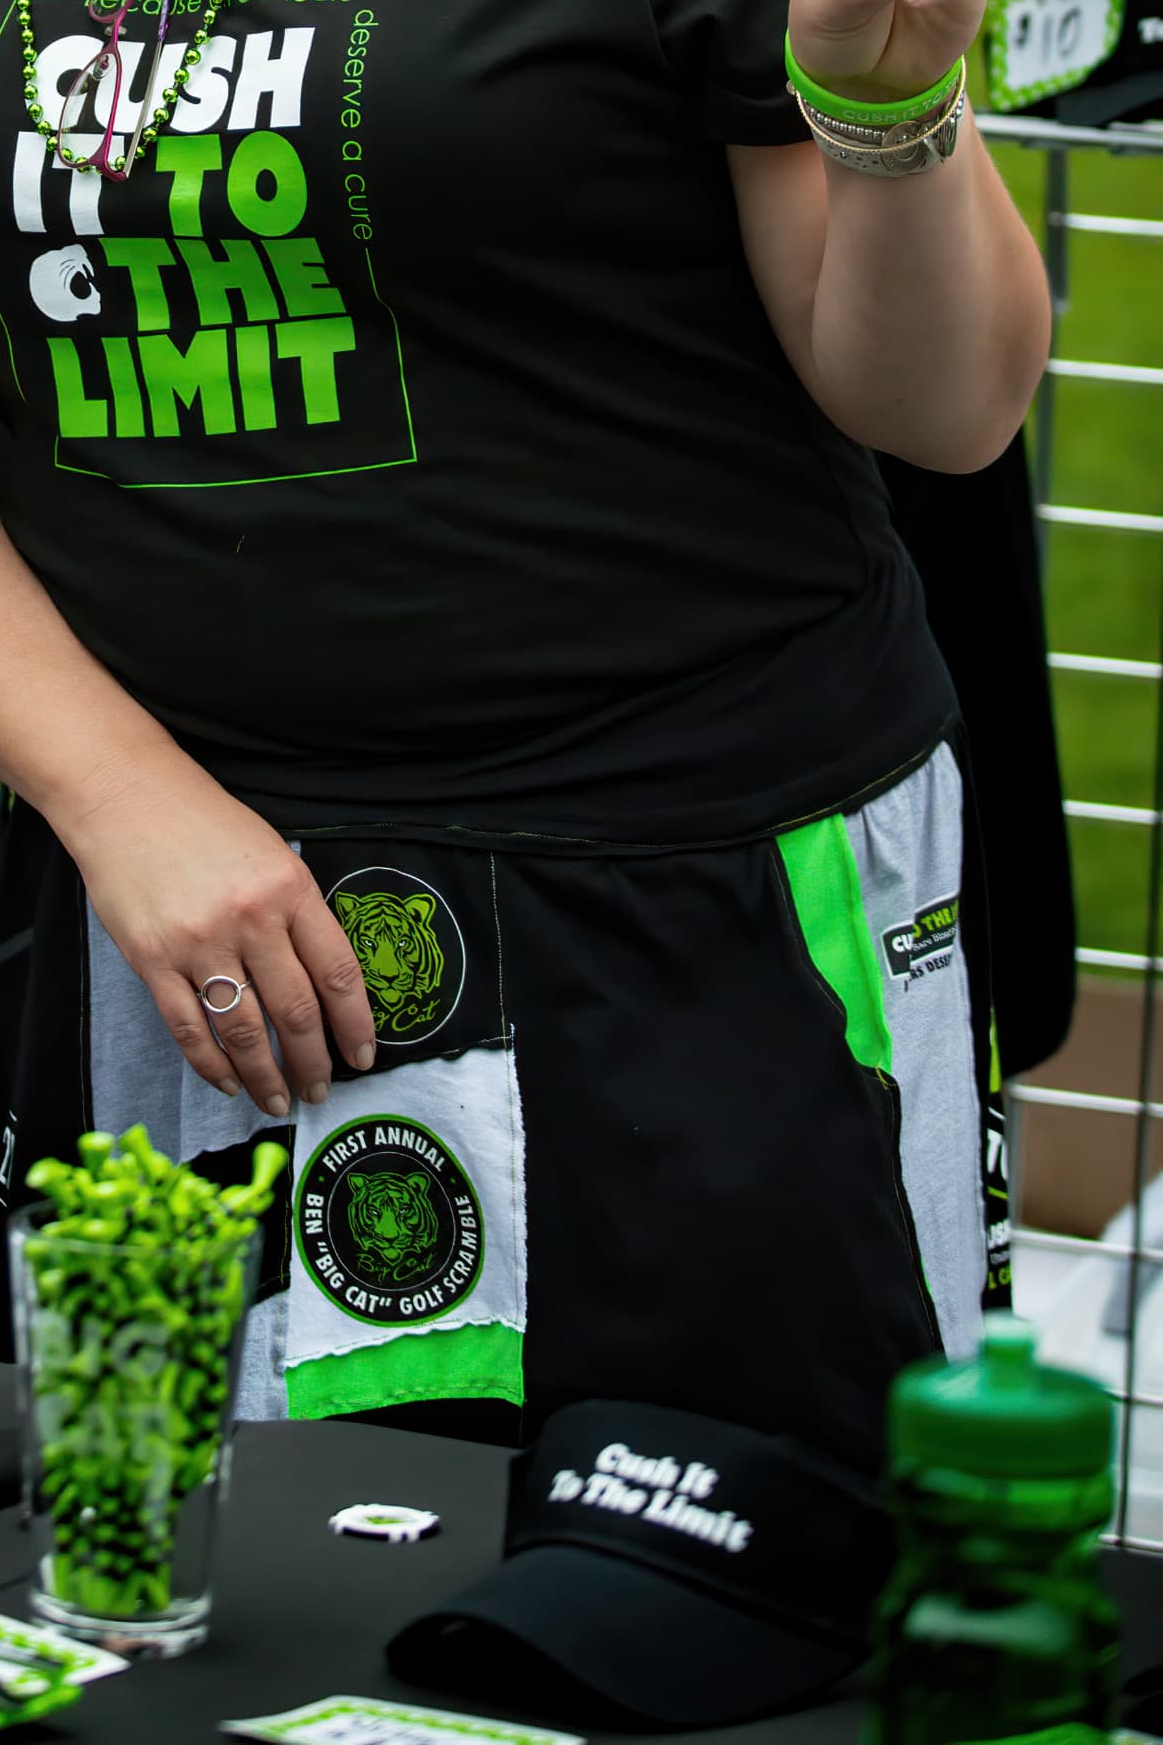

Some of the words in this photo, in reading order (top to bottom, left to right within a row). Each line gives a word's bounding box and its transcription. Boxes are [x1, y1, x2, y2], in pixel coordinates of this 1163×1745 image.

[24, 26, 316, 133] CUSH
[341, 9, 380, 128] deserve
[13, 131, 125, 236] IT
[155, 131, 308, 237] TO
[342, 140, 362, 161] a
[345, 173, 373, 240] cure
[98, 237, 347, 332] THE
[47, 316, 357, 438] LIMIT
[392, 999, 441, 1031] Cat
[322, 1130, 369, 1173] FIRST
[374, 1126, 447, 1172] ANNUAL
[305, 1193, 325, 1235] BEN
[399, 1285, 444, 1315] GOLF
[443, 1194, 478, 1294] SCRAMBLE
[595, 1443, 681, 1489] Cush
[548, 1470, 585, 1502] To
[581, 1472, 648, 1514] The
[641, 1489, 754, 1553] Limit
